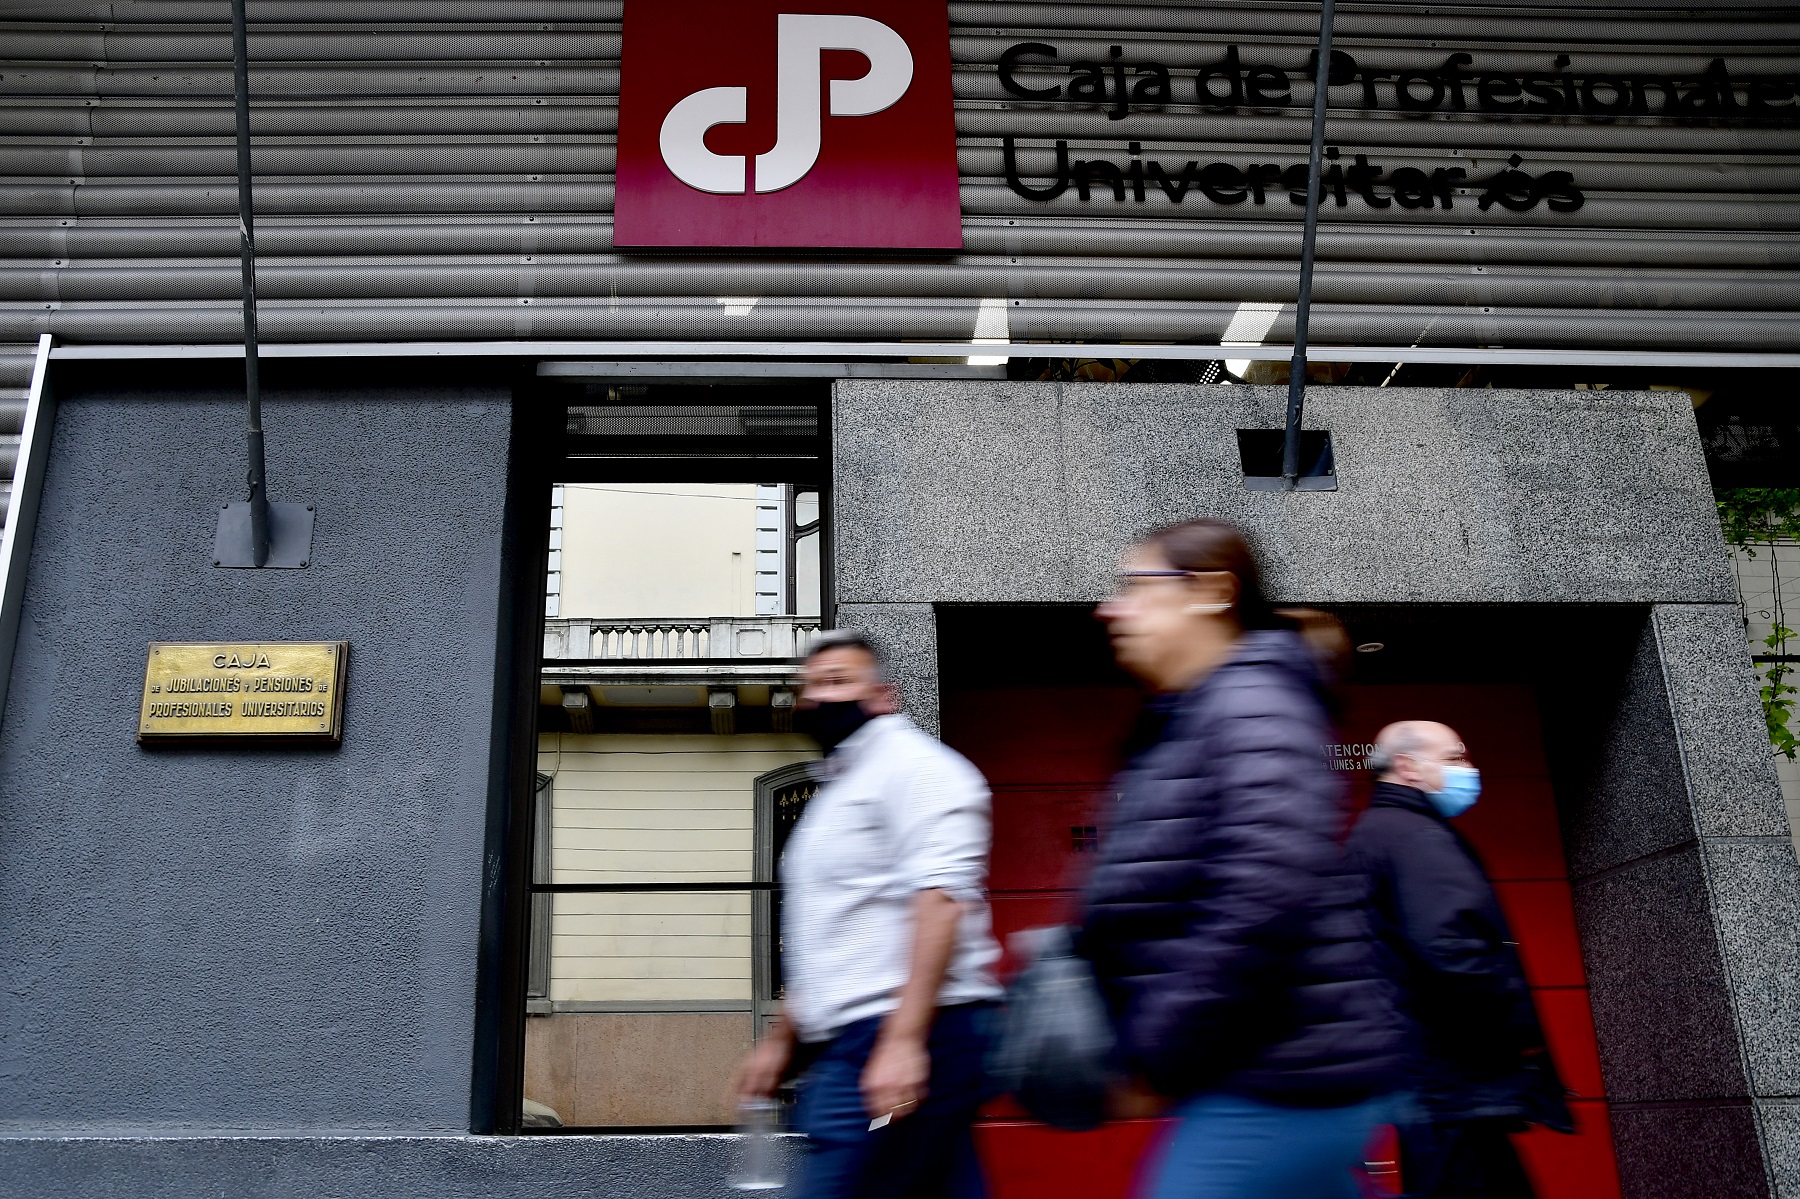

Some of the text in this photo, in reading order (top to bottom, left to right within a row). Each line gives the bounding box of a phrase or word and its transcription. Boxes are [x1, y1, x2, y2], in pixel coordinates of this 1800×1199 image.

[999, 42, 1800, 120] Caja de Profesionale
[212, 653, 271, 669] CAJA
[151, 677, 328, 694] DE JUBILACIONES Y PENSIONES DE
[149, 701, 325, 718] PROFESIONALES UNIVERSITARIOS
[1330, 758, 1355, 771] LUNES
